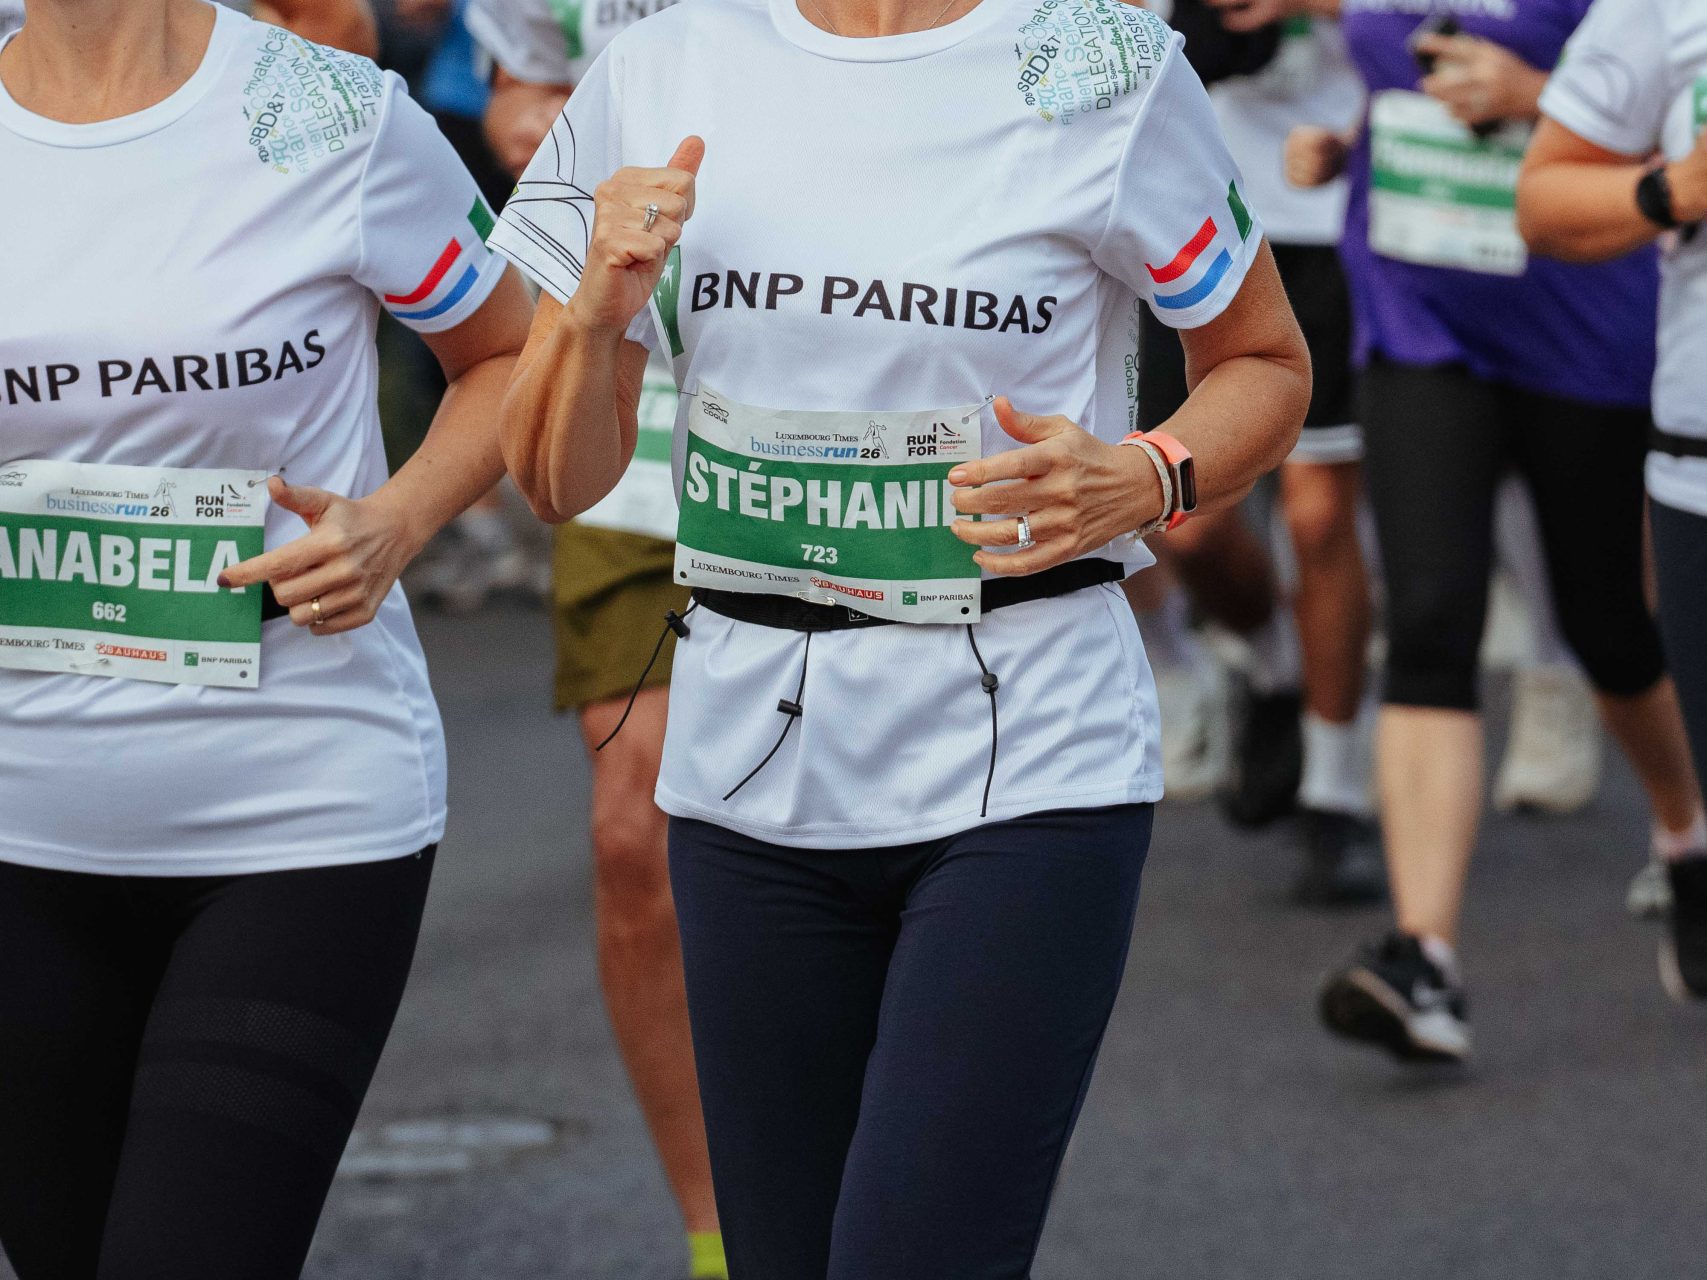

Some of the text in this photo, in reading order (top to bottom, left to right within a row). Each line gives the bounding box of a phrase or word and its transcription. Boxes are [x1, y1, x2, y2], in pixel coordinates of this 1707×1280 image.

[1068, 6, 1112, 110] DELEGATION
[286, 56, 345, 153] DELEGATION
[691, 269, 1058, 335] BNP PARIBAS
[0, 328, 326, 405] NP PARIBAS
[703, 407, 729, 425] COQUE
[775, 431, 859, 443] LUXEMBOURG TIMES
[906, 434, 937, 446] RUN
[859, 448, 881, 459] 26
[907, 445, 937, 457] FOR
[195, 495, 224, 506] RUN
[150, 505, 170, 517] 26
[196, 507, 224, 517] FOR
[0, 526, 247, 595] ANABELA
[800, 543, 839, 564] 723
[690, 558, 801, 584] LUXEMBOURG TIMES
[820, 578, 884, 601] BAUHAUS
[939, 593, 974, 602] PARIBAS
[92, 601, 127, 622] 662
[0, 637, 86, 651] EMBOURG TIMES
[105, 644, 167, 662] BAUHAUS
